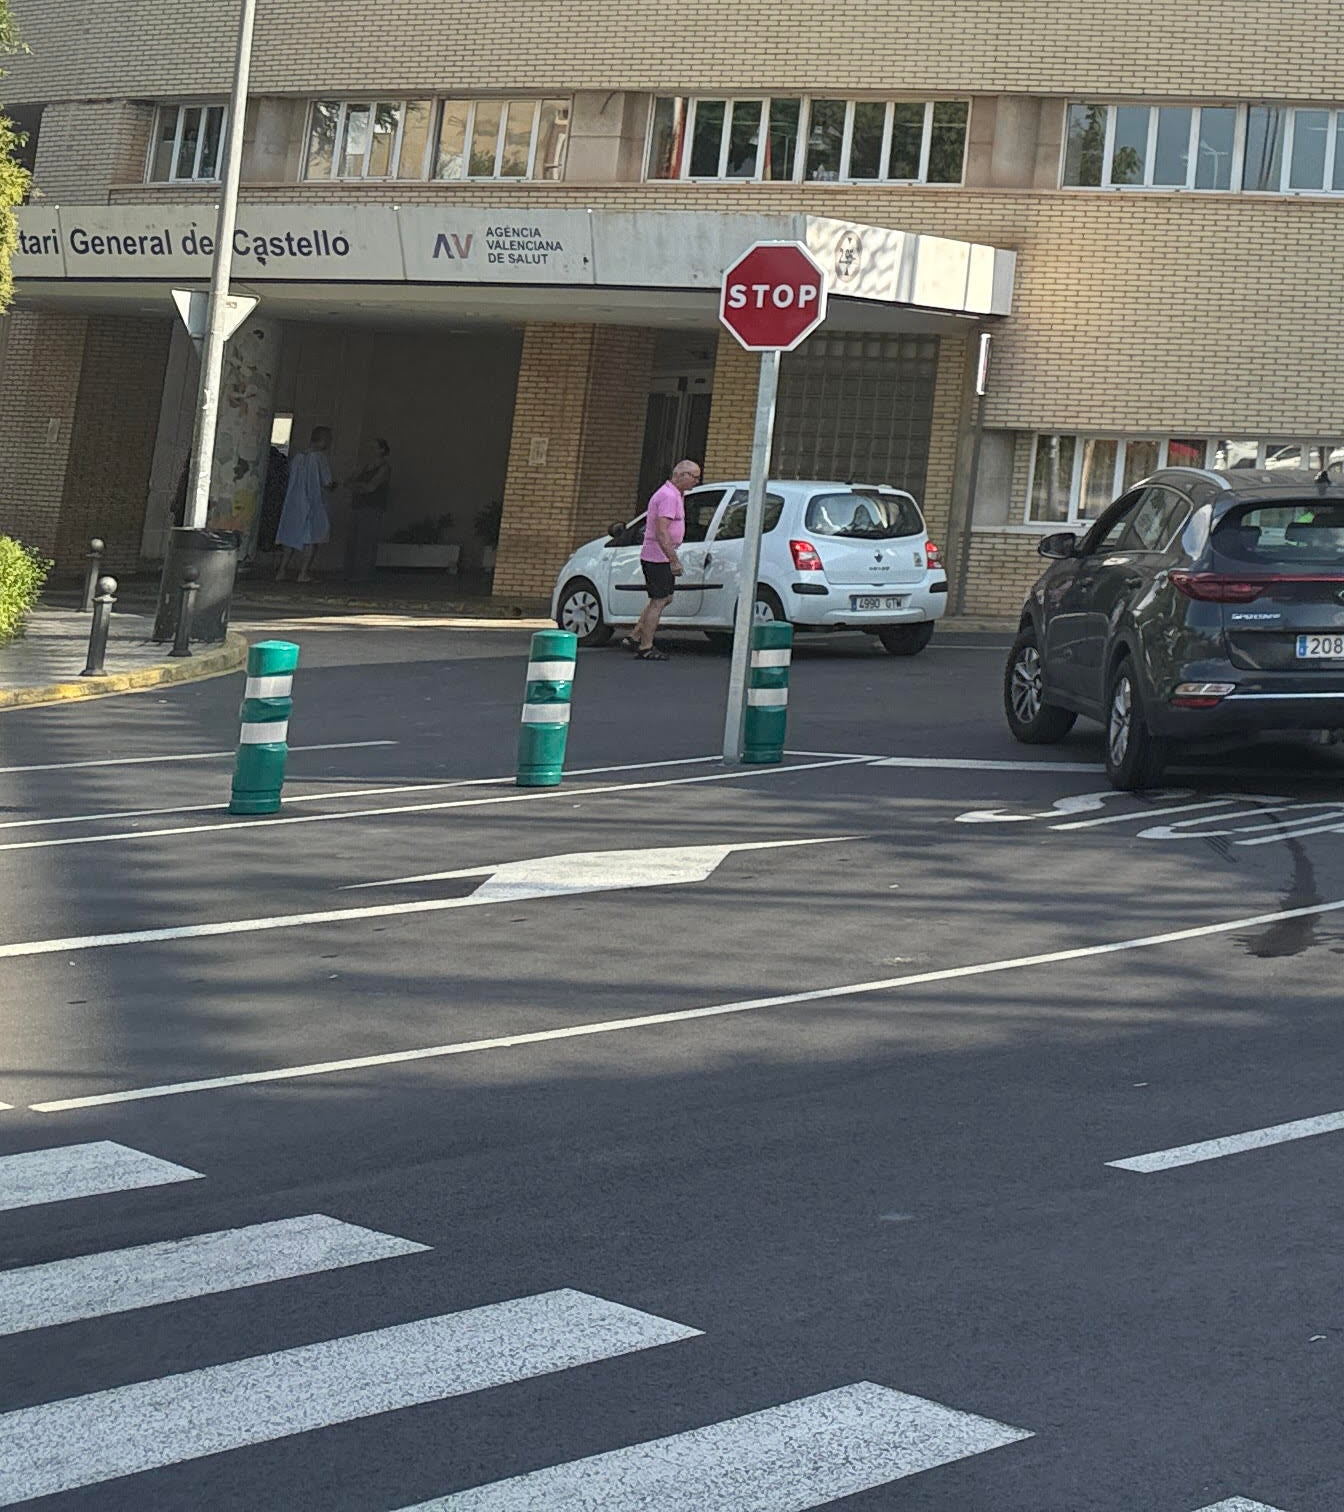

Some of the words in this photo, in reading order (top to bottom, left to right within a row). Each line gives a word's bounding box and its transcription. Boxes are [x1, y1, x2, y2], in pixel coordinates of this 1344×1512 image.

[18, 228, 59, 255] tari
[69, 228, 172, 256] General
[182, 229, 215, 256] de
[487, 240, 563, 251] VALENCIANA
[488, 253, 504, 263] DE
[508, 254, 548, 264] SALUT
[728, 284, 817, 308] STOP
